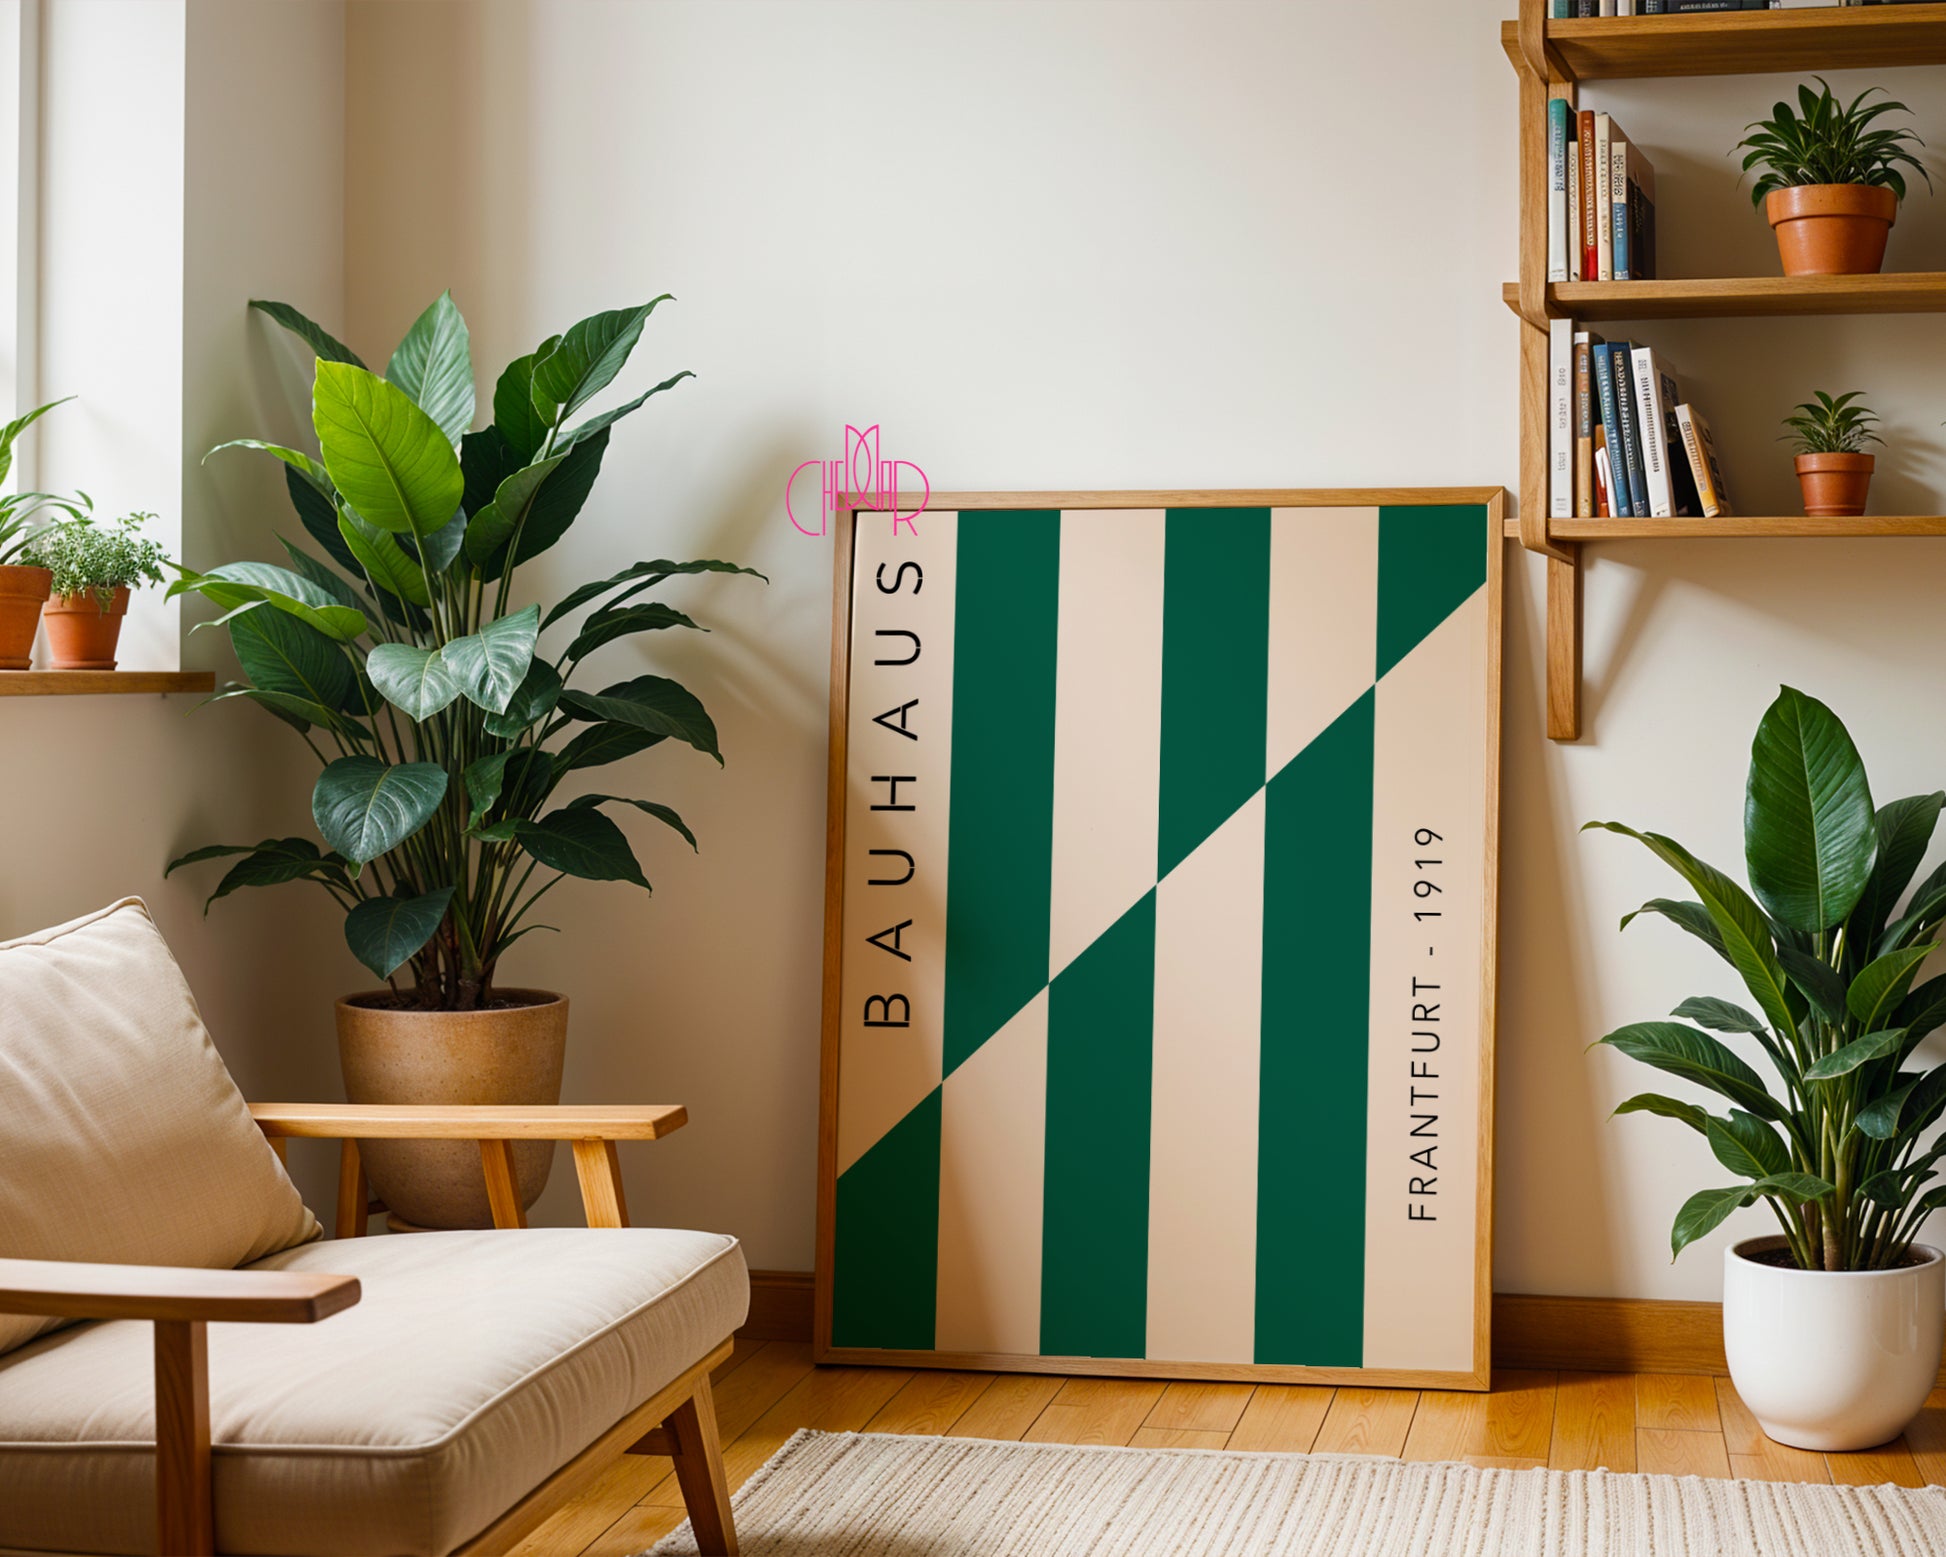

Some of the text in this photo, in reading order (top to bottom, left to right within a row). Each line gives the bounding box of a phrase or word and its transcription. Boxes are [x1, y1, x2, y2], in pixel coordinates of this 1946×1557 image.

[863, 561, 923, 1030] BAUHAUS
[1412, 828, 1444, 923] 1919
[1408, 976, 1442, 1221] FRANTFURT
